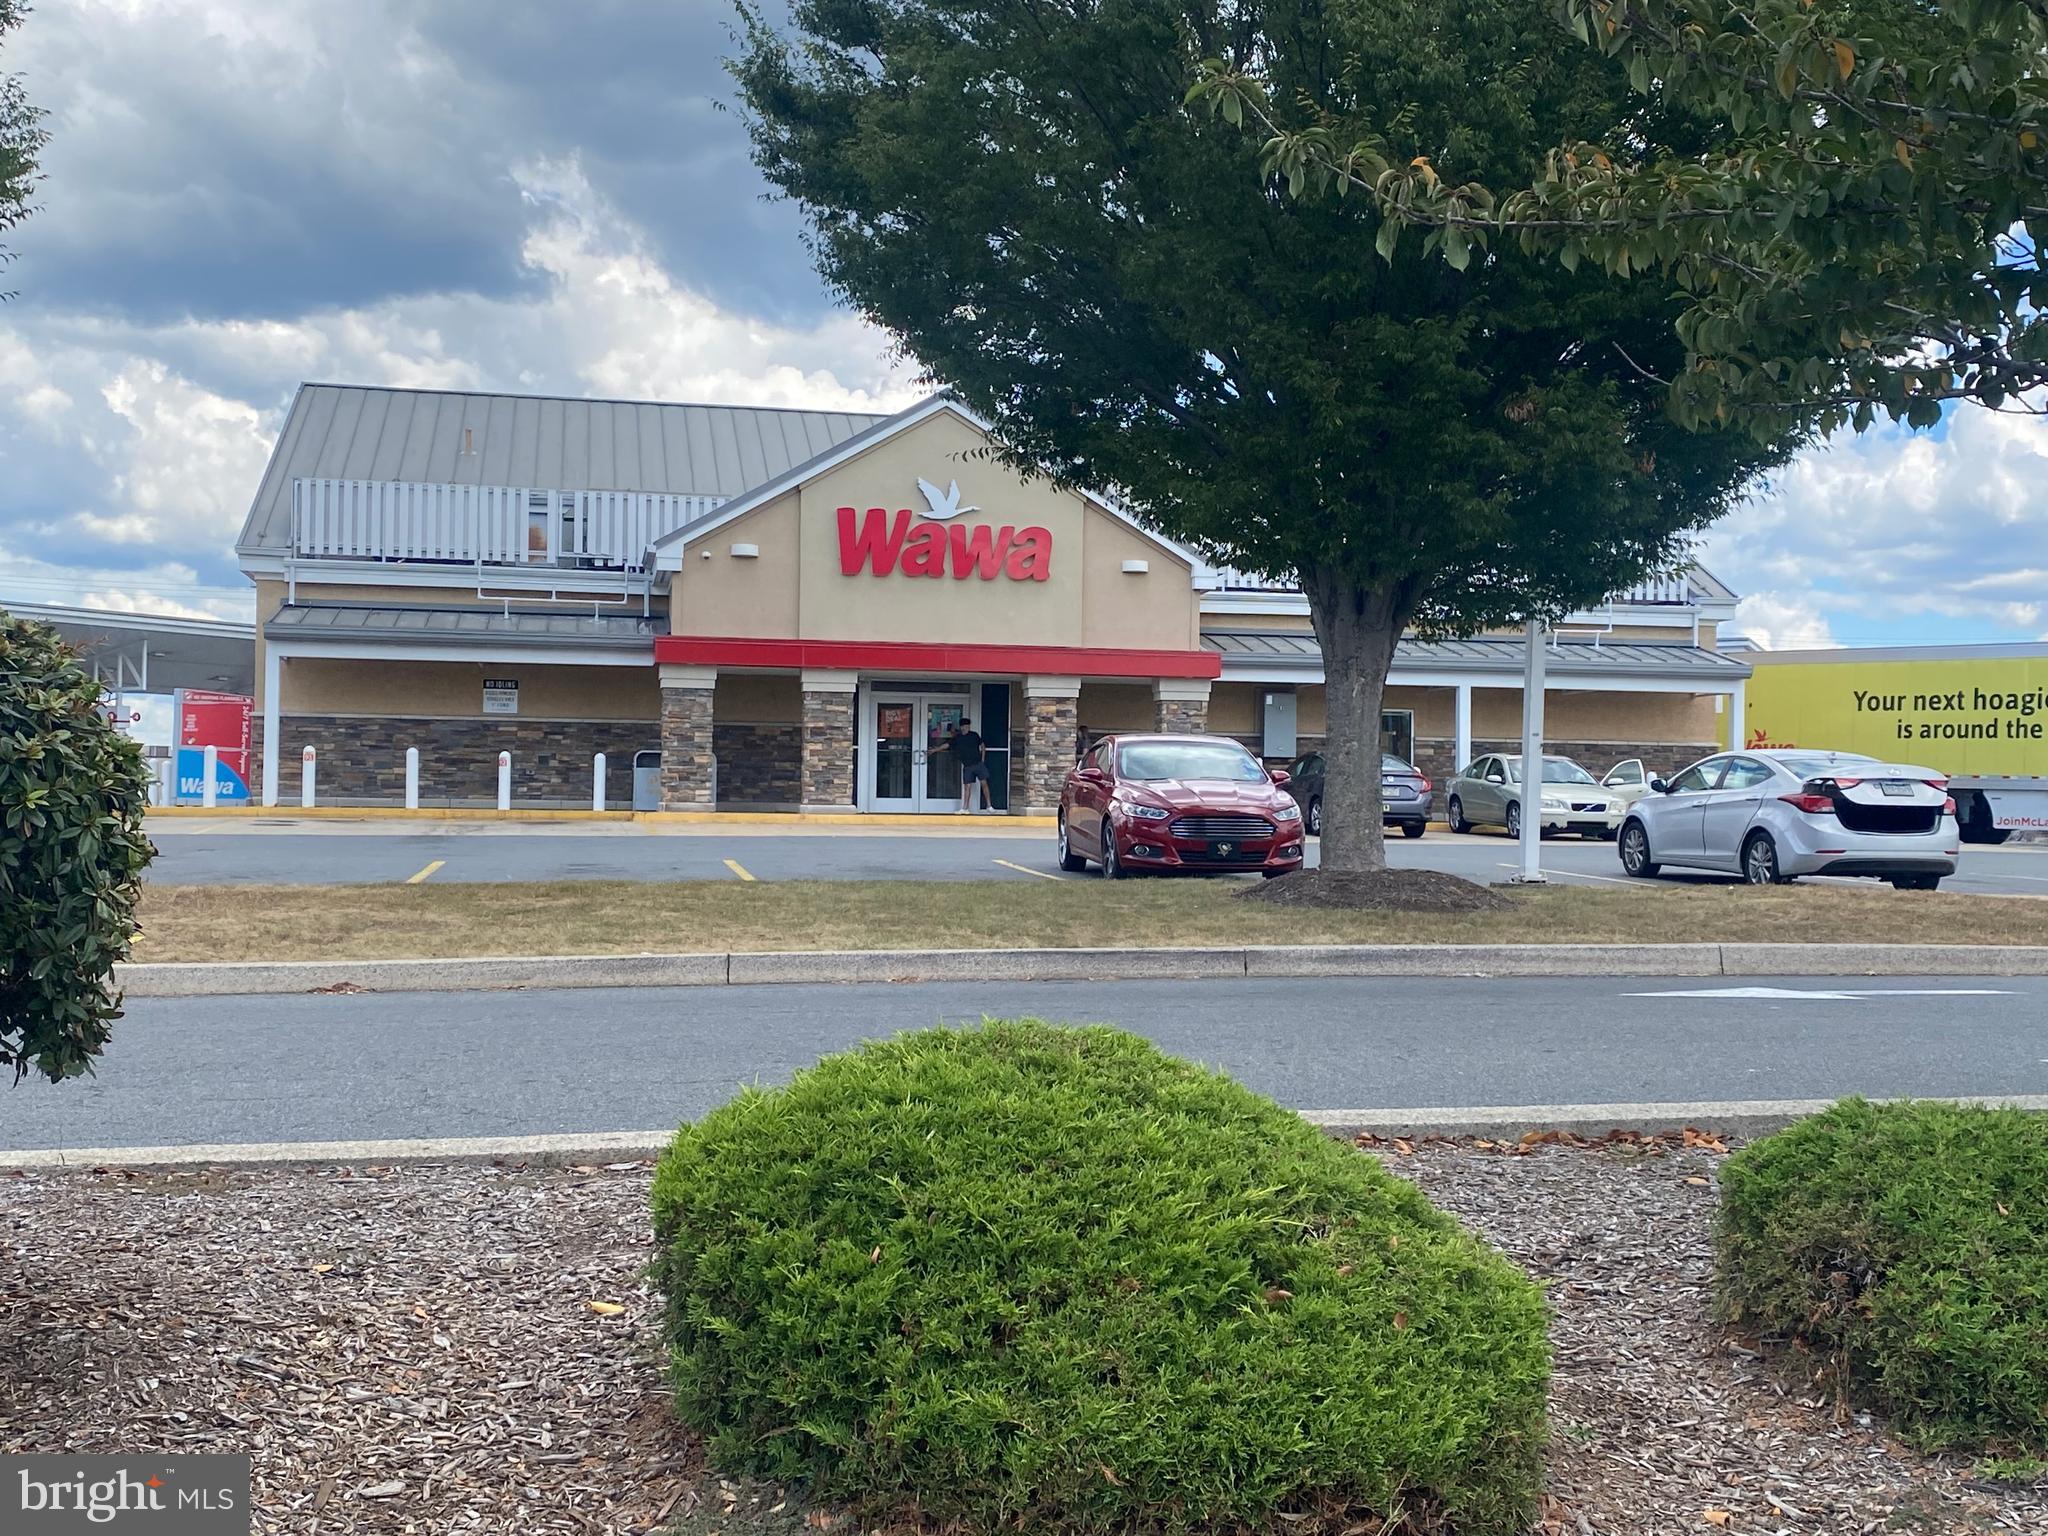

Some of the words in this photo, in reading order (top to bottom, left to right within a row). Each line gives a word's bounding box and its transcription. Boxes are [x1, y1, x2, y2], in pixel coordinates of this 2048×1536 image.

[837, 507, 1053, 582] Wawa
[1853, 691, 1906, 711] Your
[1913, 691, 1965, 711] next
[1973, 687, 2048, 716] hoagi
[1897, 719, 1913, 739] is
[1919, 717, 1998, 739] around
[2006, 718, 2043, 739] the
